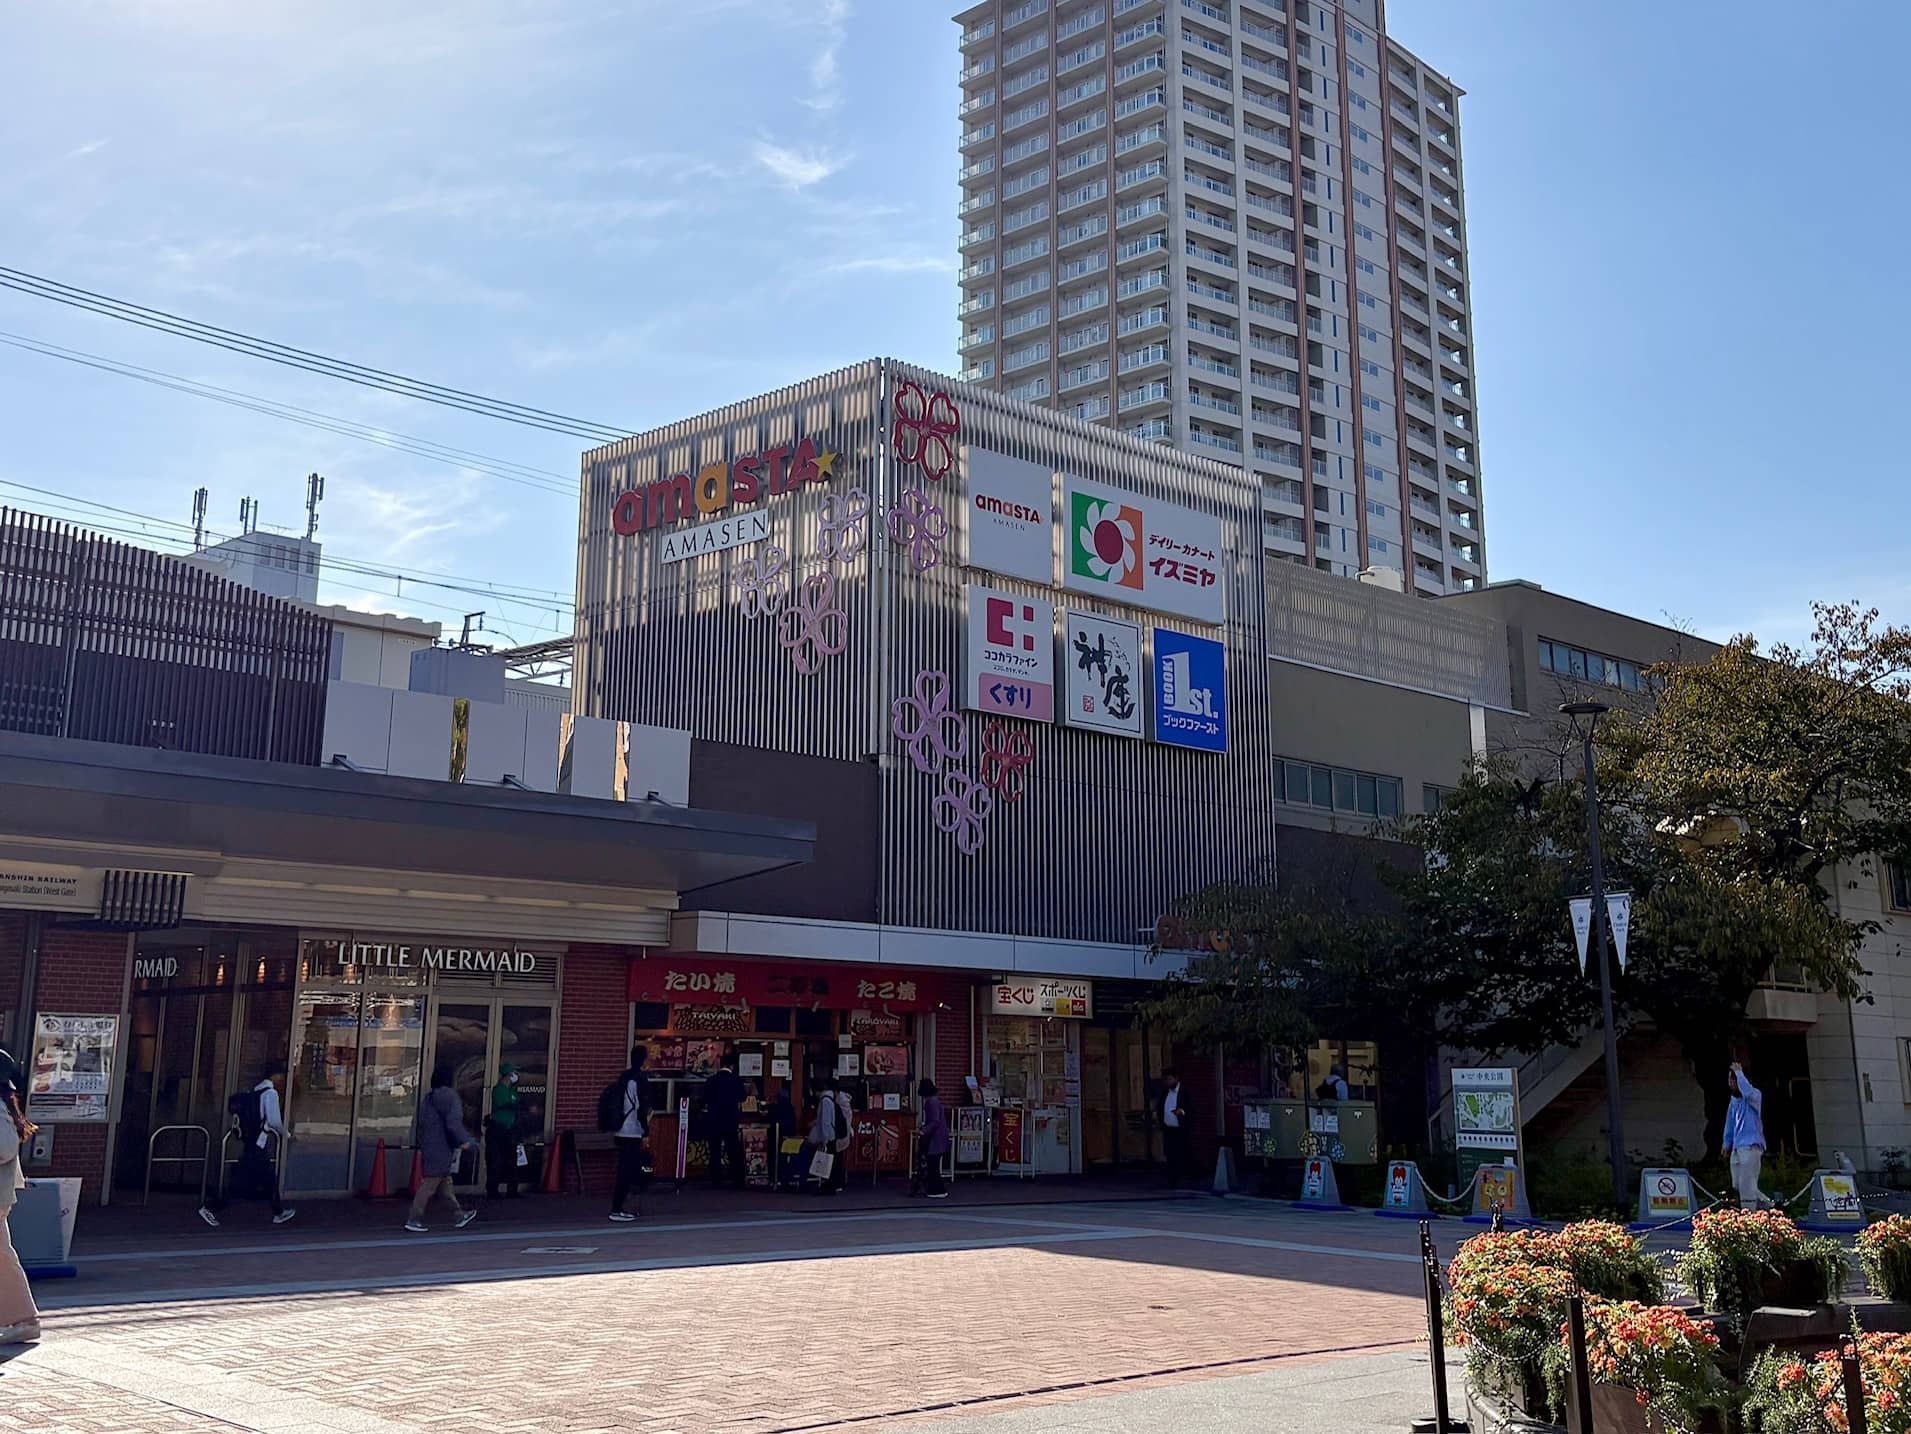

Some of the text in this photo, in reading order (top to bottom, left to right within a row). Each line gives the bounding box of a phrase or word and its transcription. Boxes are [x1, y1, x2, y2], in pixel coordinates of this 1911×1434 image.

[993, 518, 1026, 532] AMASEN
[662, 514, 768, 560] AMASEN
[1149, 557, 1216, 588] イズミヤ
[984, 650, 1038, 668] ココカラファイン
[1162, 657, 1174, 707] BOOK
[989, 683, 1032, 709] くすり
[1162, 714, 1219, 735] ブックファースト
[38, 877, 77, 885] RAILWAY
[338, 943, 536, 973] LITTLE MERMAID
[664, 970, 737, 994] たい焼
[857, 979, 917, 1002] たこ焼
[1040, 981, 1086, 999] スポーツくじ
[997, 985, 1034, 1005] 宝くじ
[692, 1011, 736, 1020] TAIYAKI
[1003, 1112, 1019, 1162] 宝くじ
